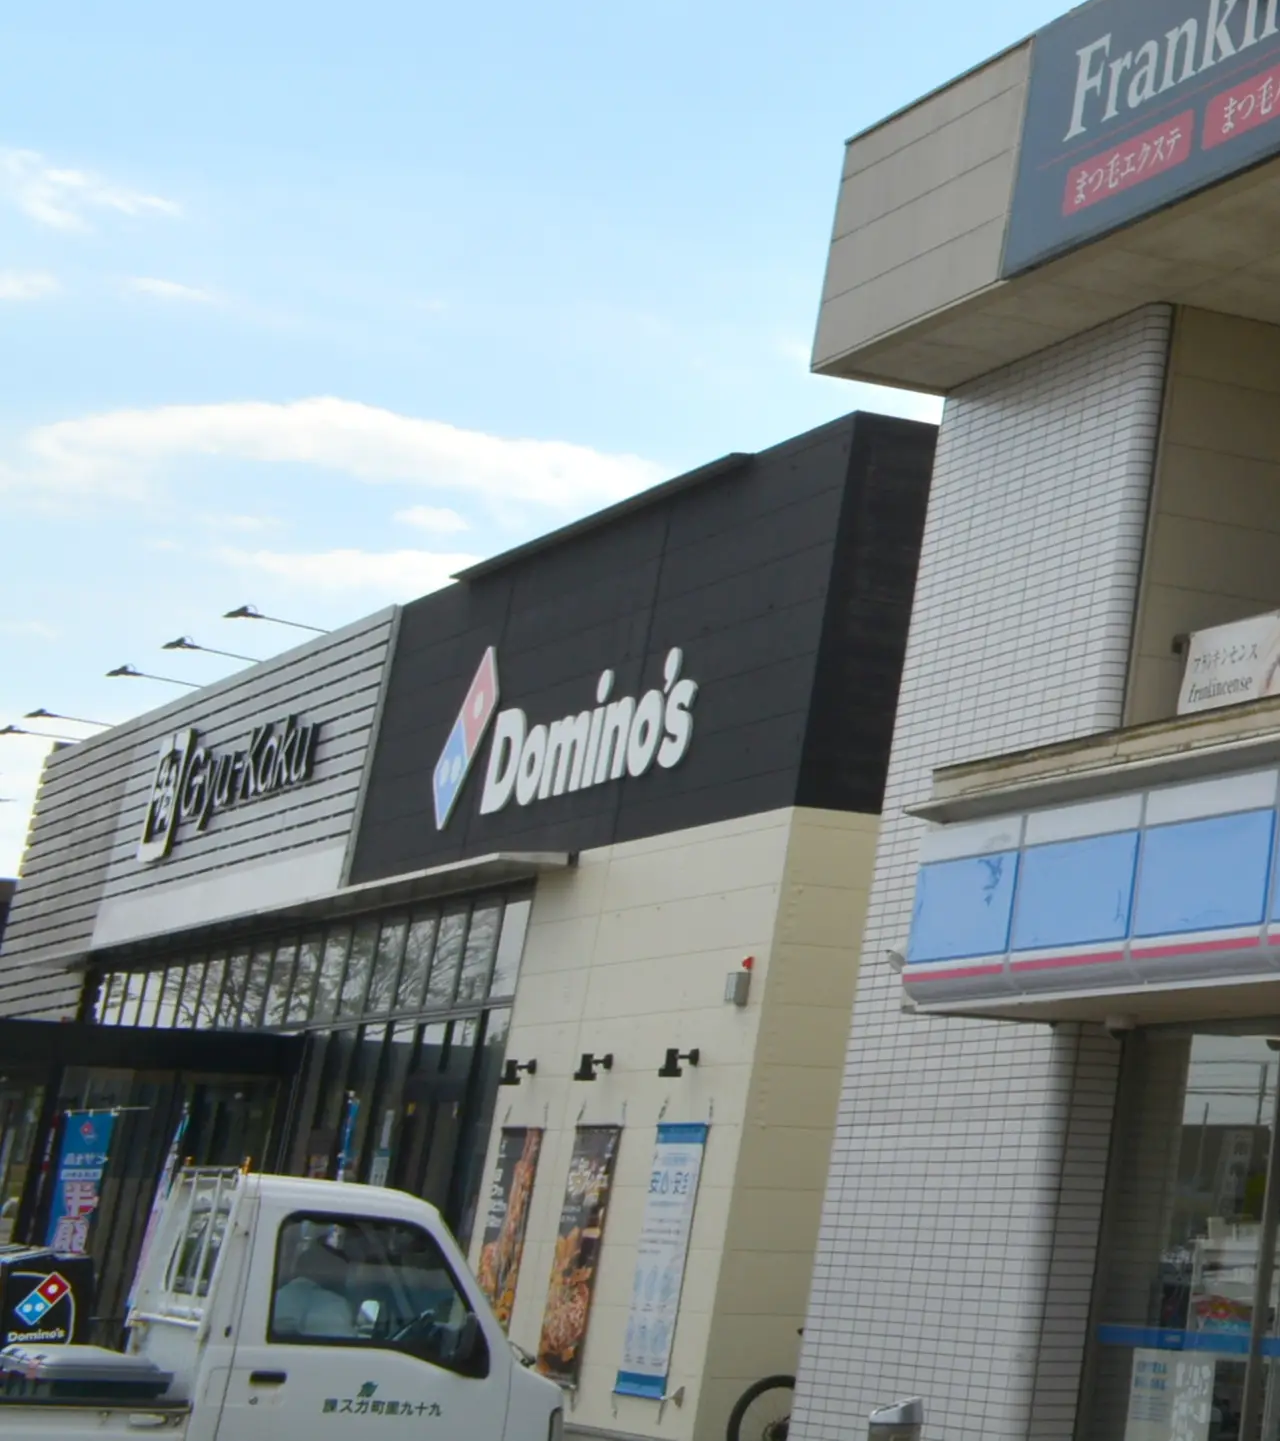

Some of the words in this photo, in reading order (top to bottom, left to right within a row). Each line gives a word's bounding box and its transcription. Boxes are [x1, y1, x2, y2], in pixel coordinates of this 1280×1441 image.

[1072, 127, 1183, 206] まつ毛エクステ
[180, 713, 319, 833] Gyu-Kaku
[479, 646, 699, 815] Domino's
[7, 1327, 66, 1343] Domino's
